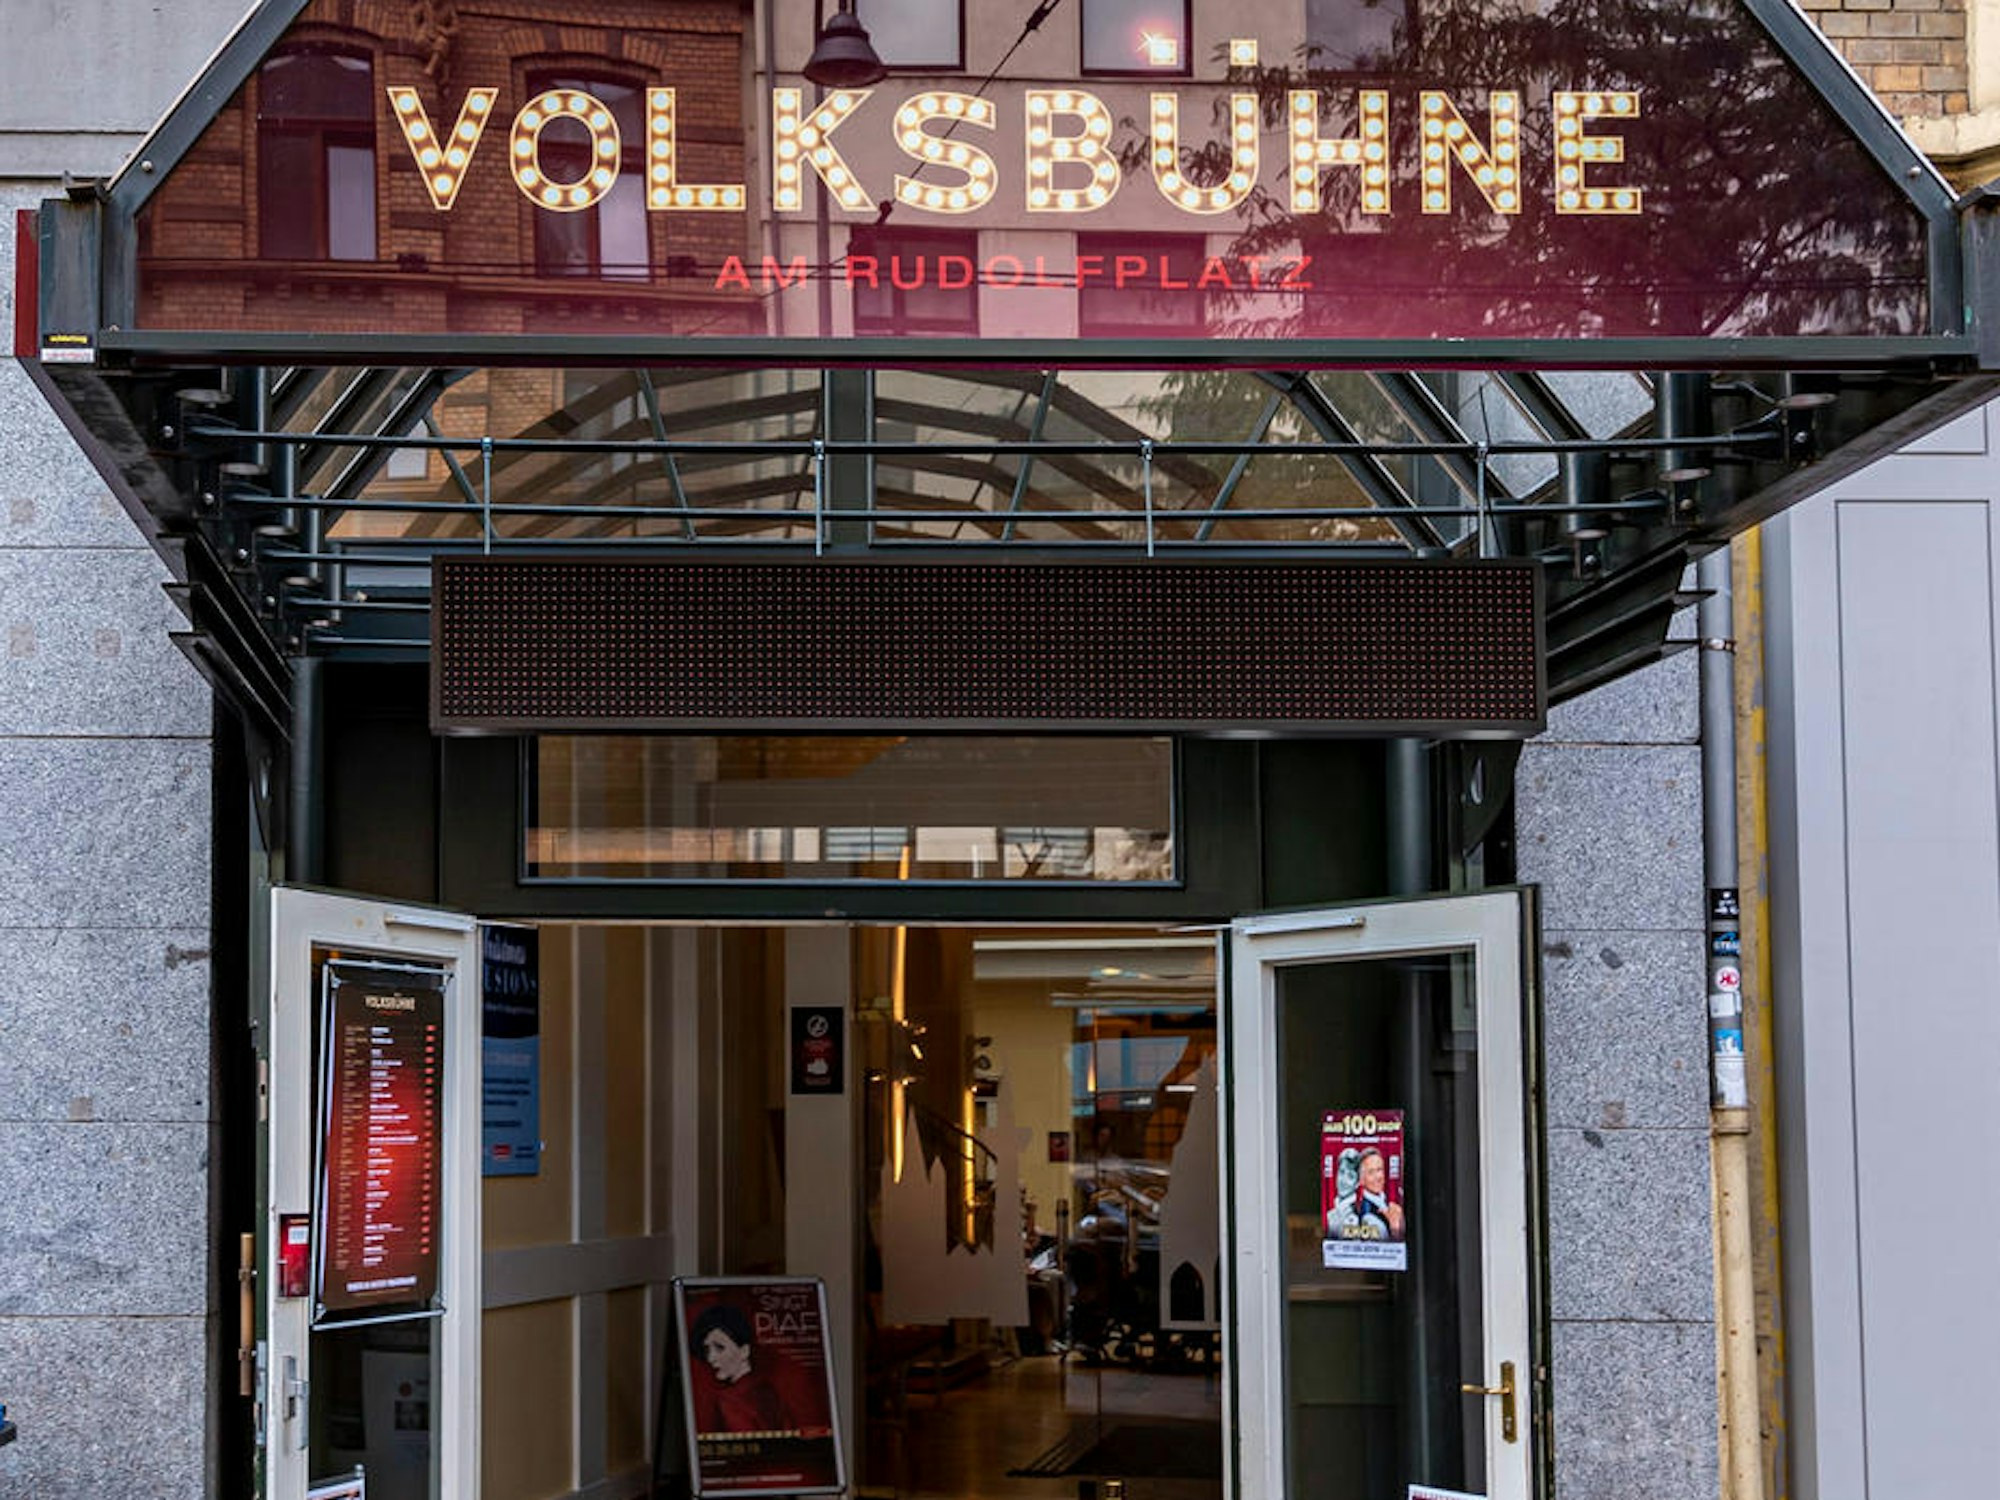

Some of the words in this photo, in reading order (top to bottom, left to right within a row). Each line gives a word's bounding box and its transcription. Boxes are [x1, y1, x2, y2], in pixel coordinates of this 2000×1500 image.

[387, 39, 1643, 215] VOLKSBÜHNE
[714, 255, 809, 290] AM
[845, 255, 1314, 292] RUDOLFPLATZ
[1343, 1114, 1377, 1136] 100
